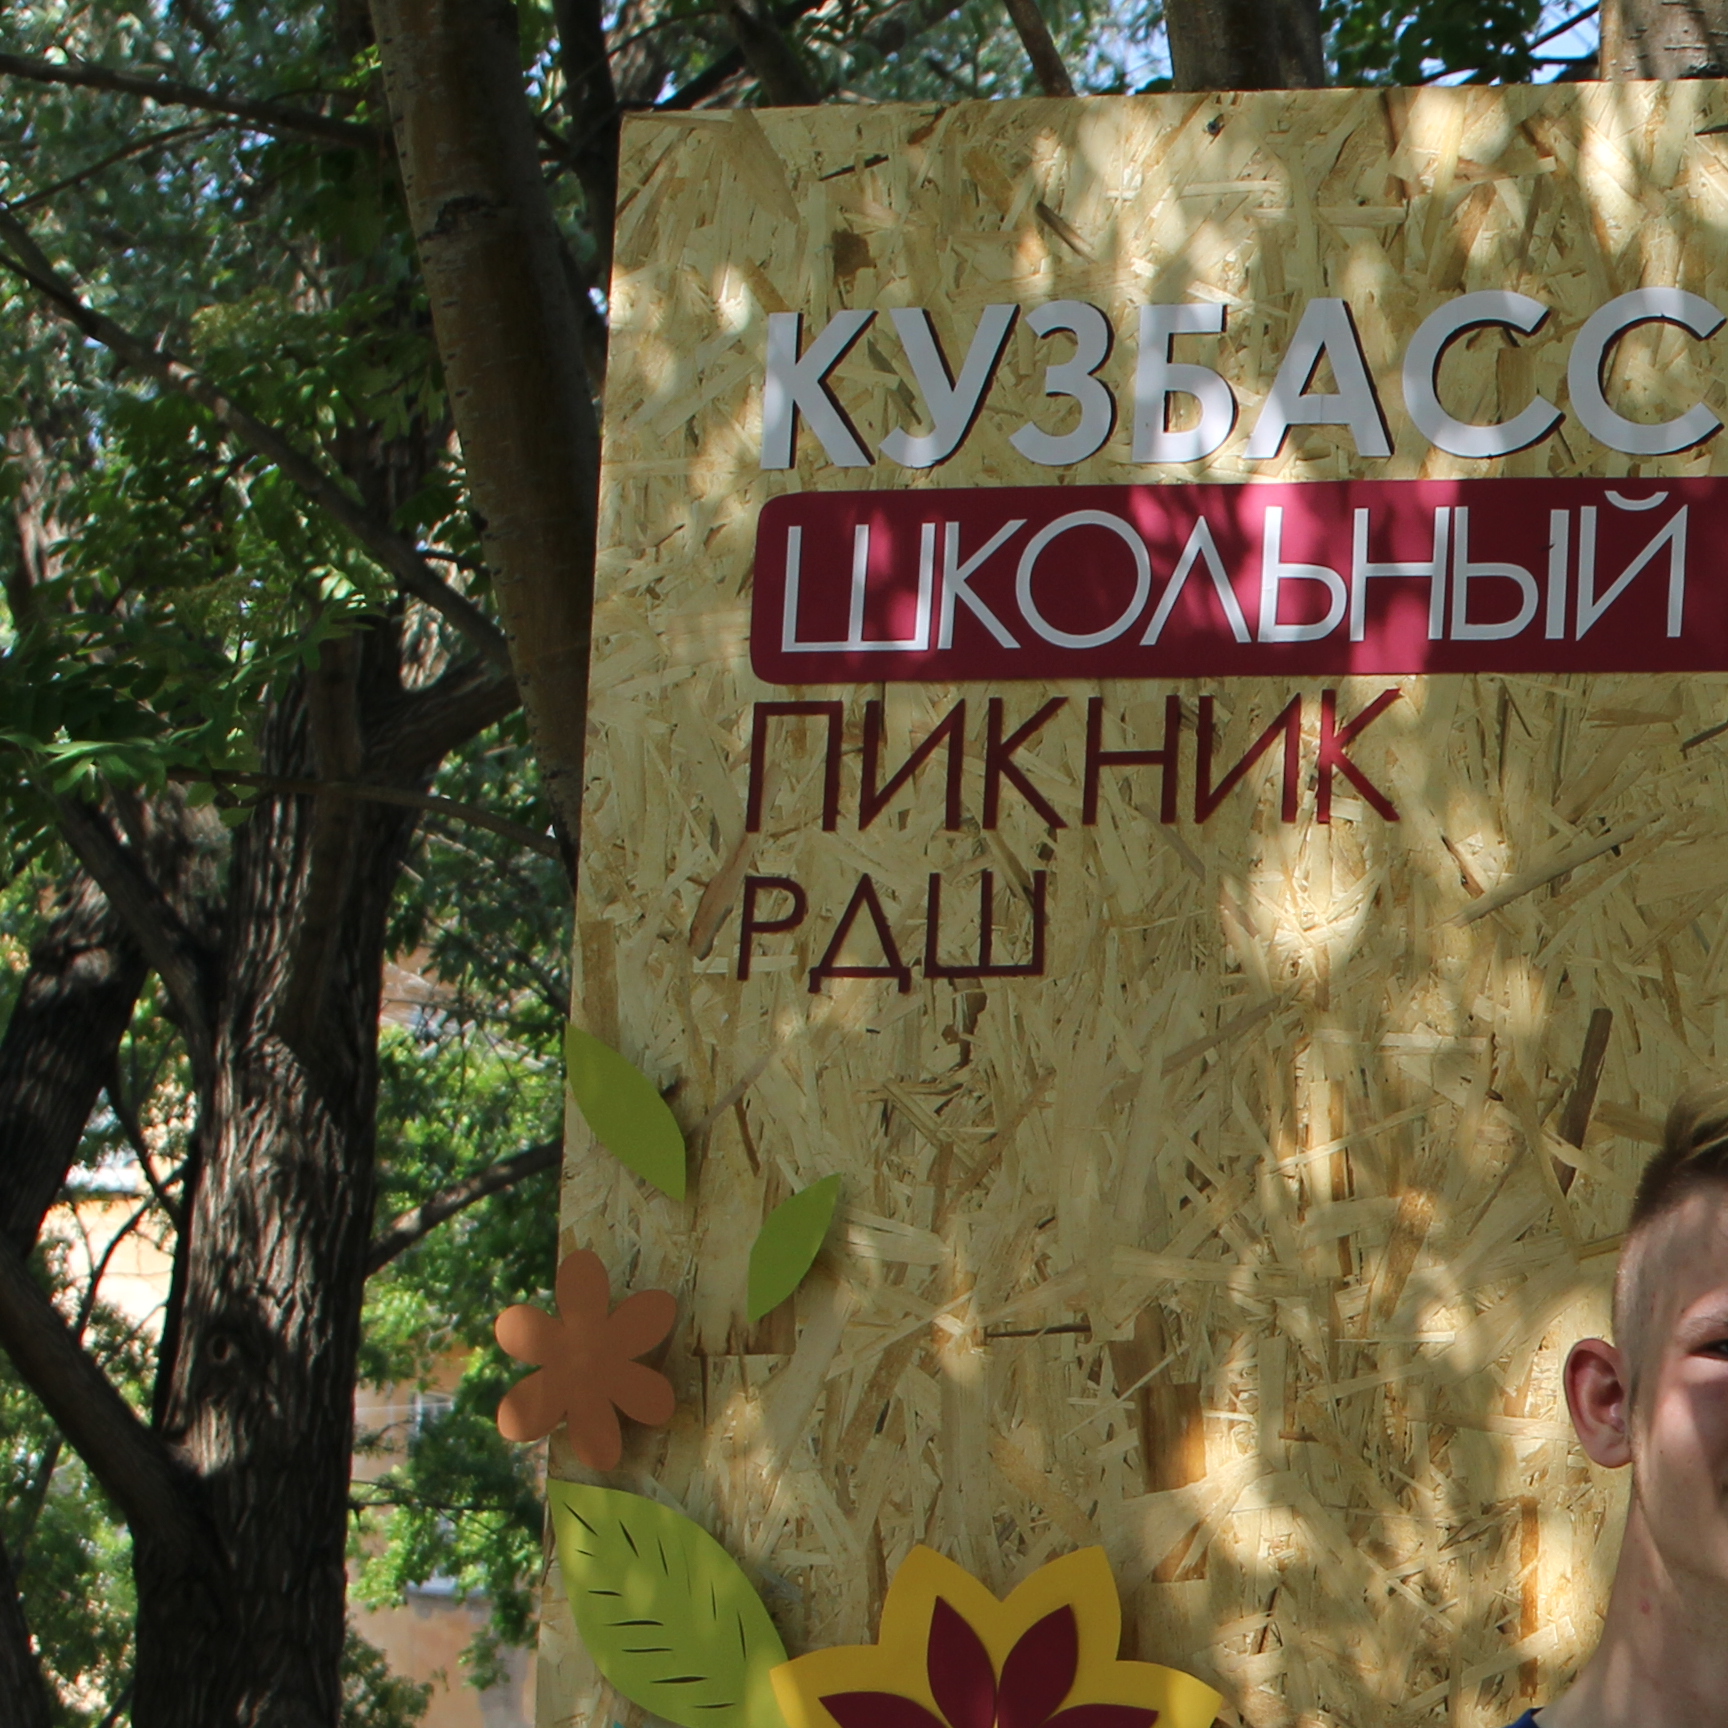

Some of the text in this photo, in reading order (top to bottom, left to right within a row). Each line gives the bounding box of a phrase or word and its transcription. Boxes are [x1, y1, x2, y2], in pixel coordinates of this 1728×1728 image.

[781, 490, 1689, 653] ШКОЛЬНЫЙ
[746, 687, 1400, 832] ПИКНИК
[735, 868, 1048, 993] РДШ
